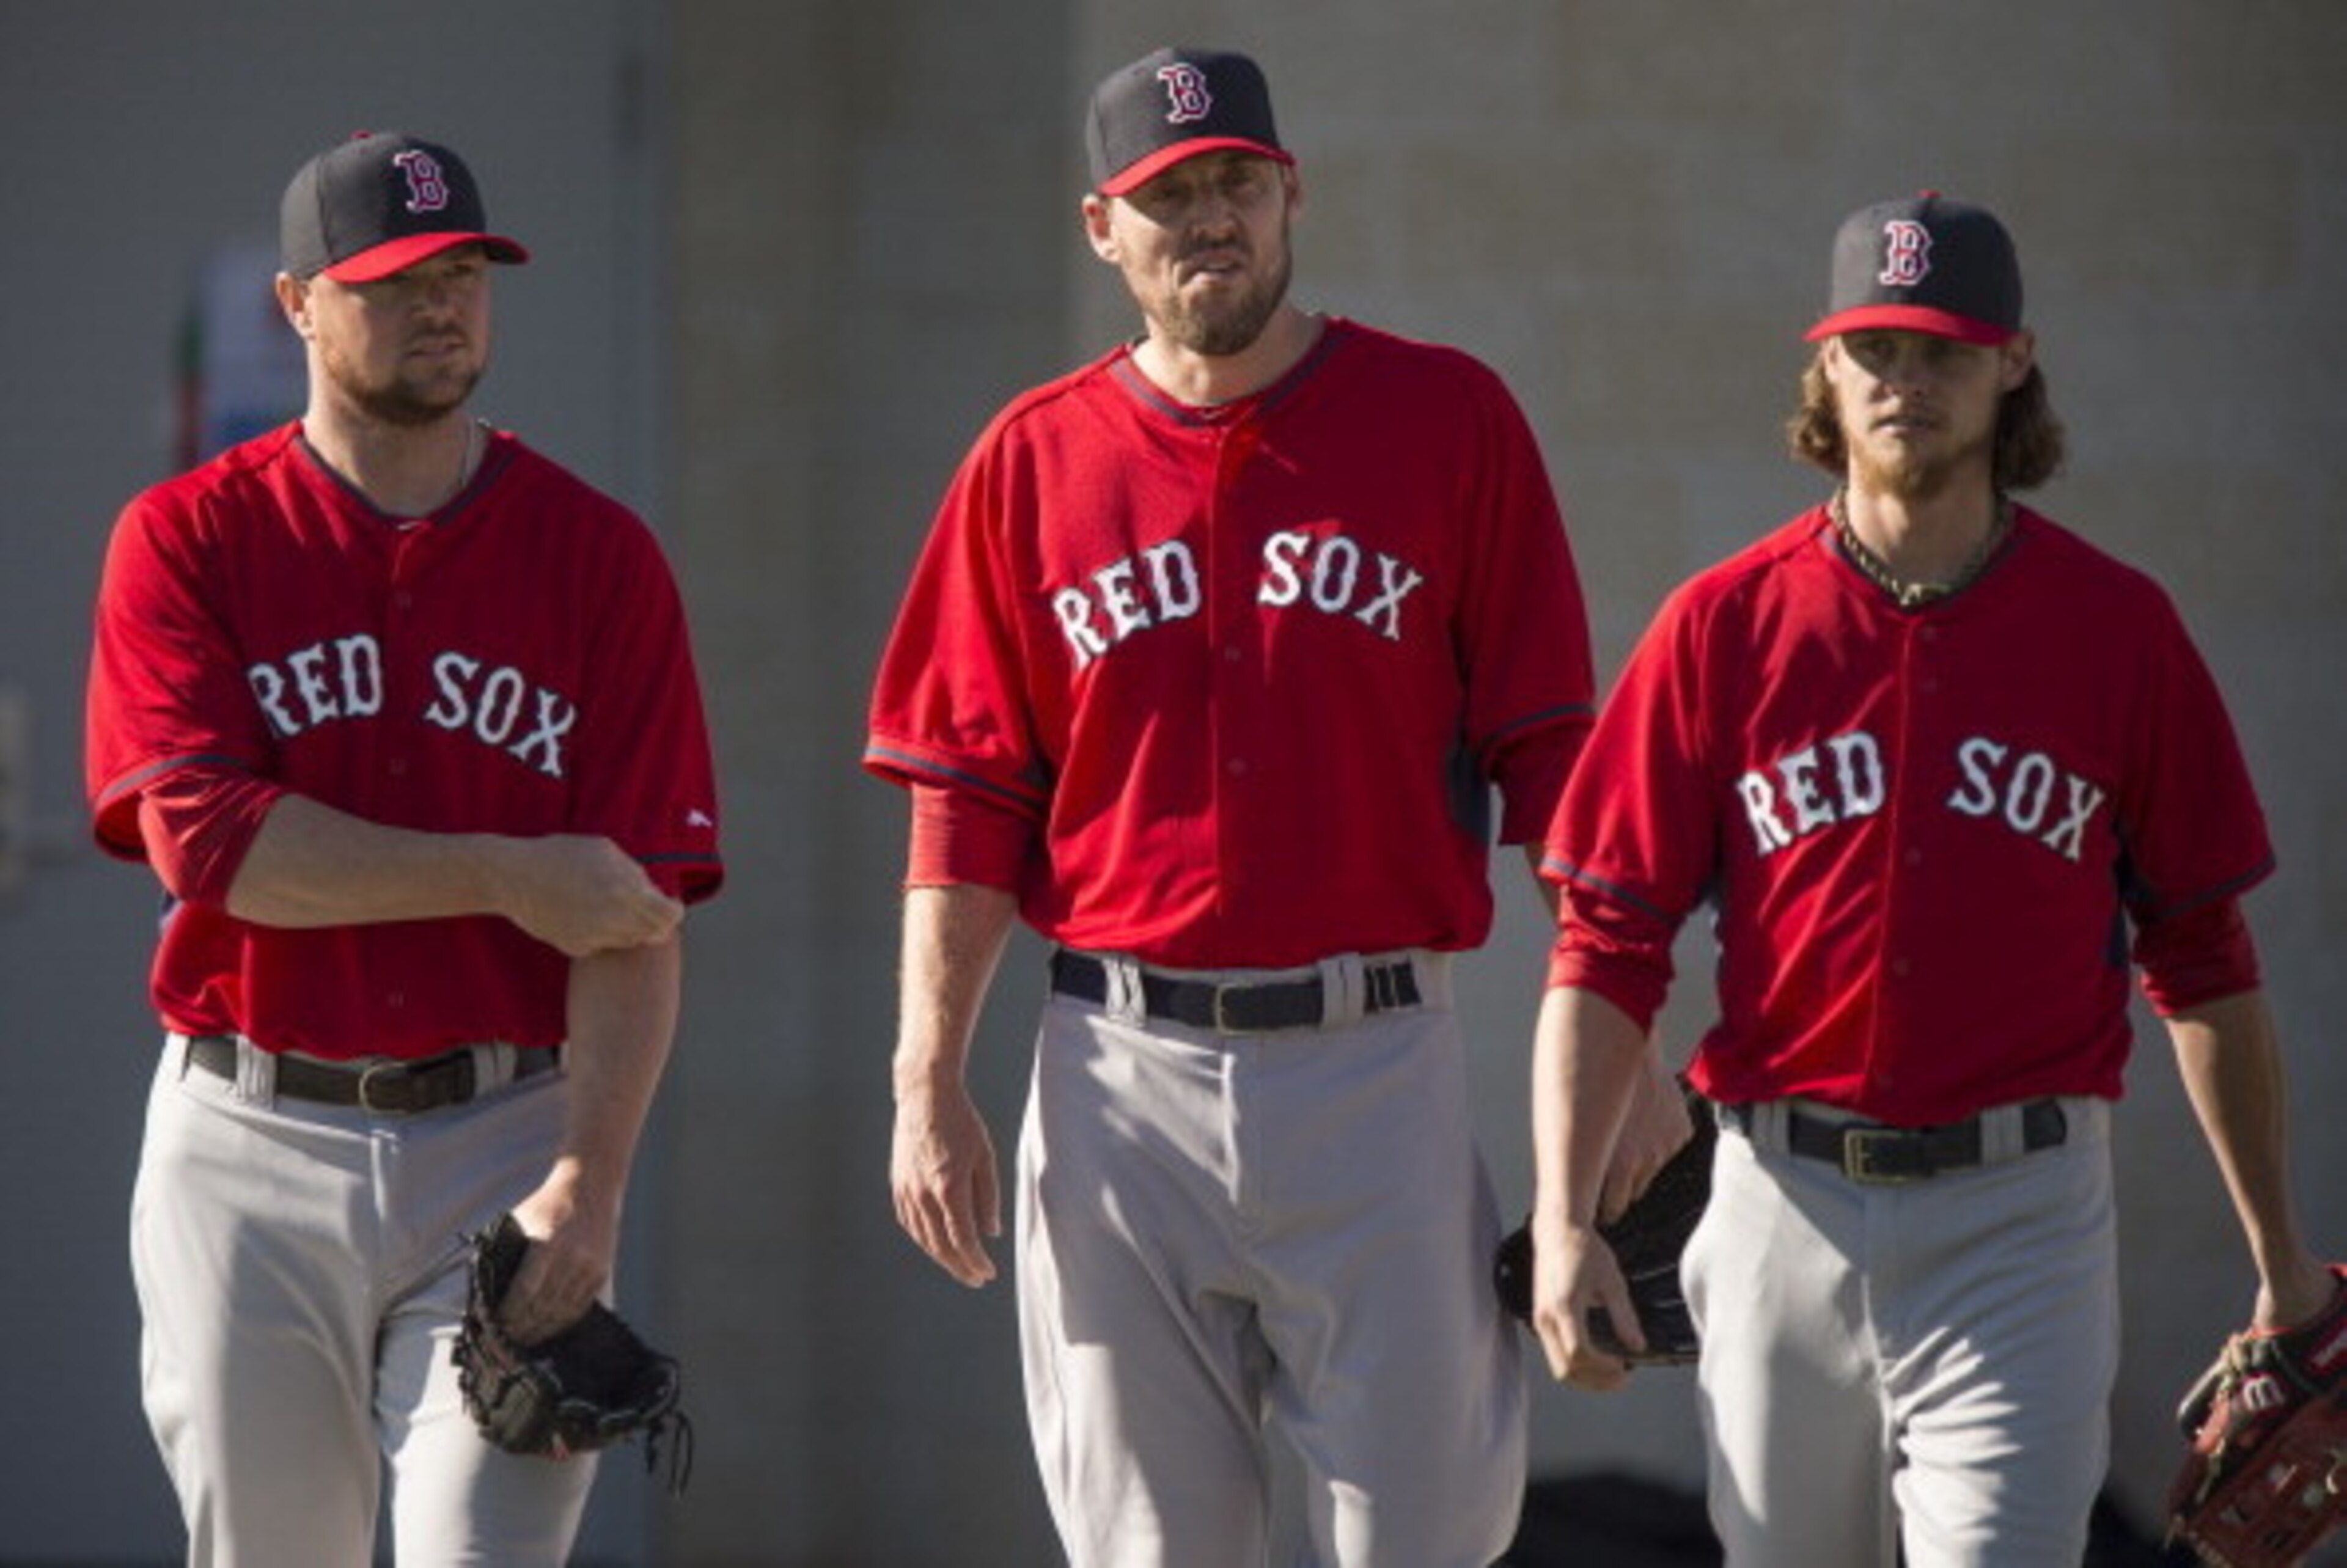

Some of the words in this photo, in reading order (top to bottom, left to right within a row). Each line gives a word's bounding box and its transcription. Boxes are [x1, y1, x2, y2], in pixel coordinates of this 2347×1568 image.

[1156, 63, 1213, 123] B
[393, 150, 450, 213] B
[1878, 220, 1933, 285] B
[1052, 540, 1202, 672] RED
[1257, 532, 1424, 640] SOX
[248, 633, 383, 737] RED
[424, 651, 576, 779] SOX
[1736, 731, 1886, 855] RED
[1947, 737, 2106, 861] SOX
